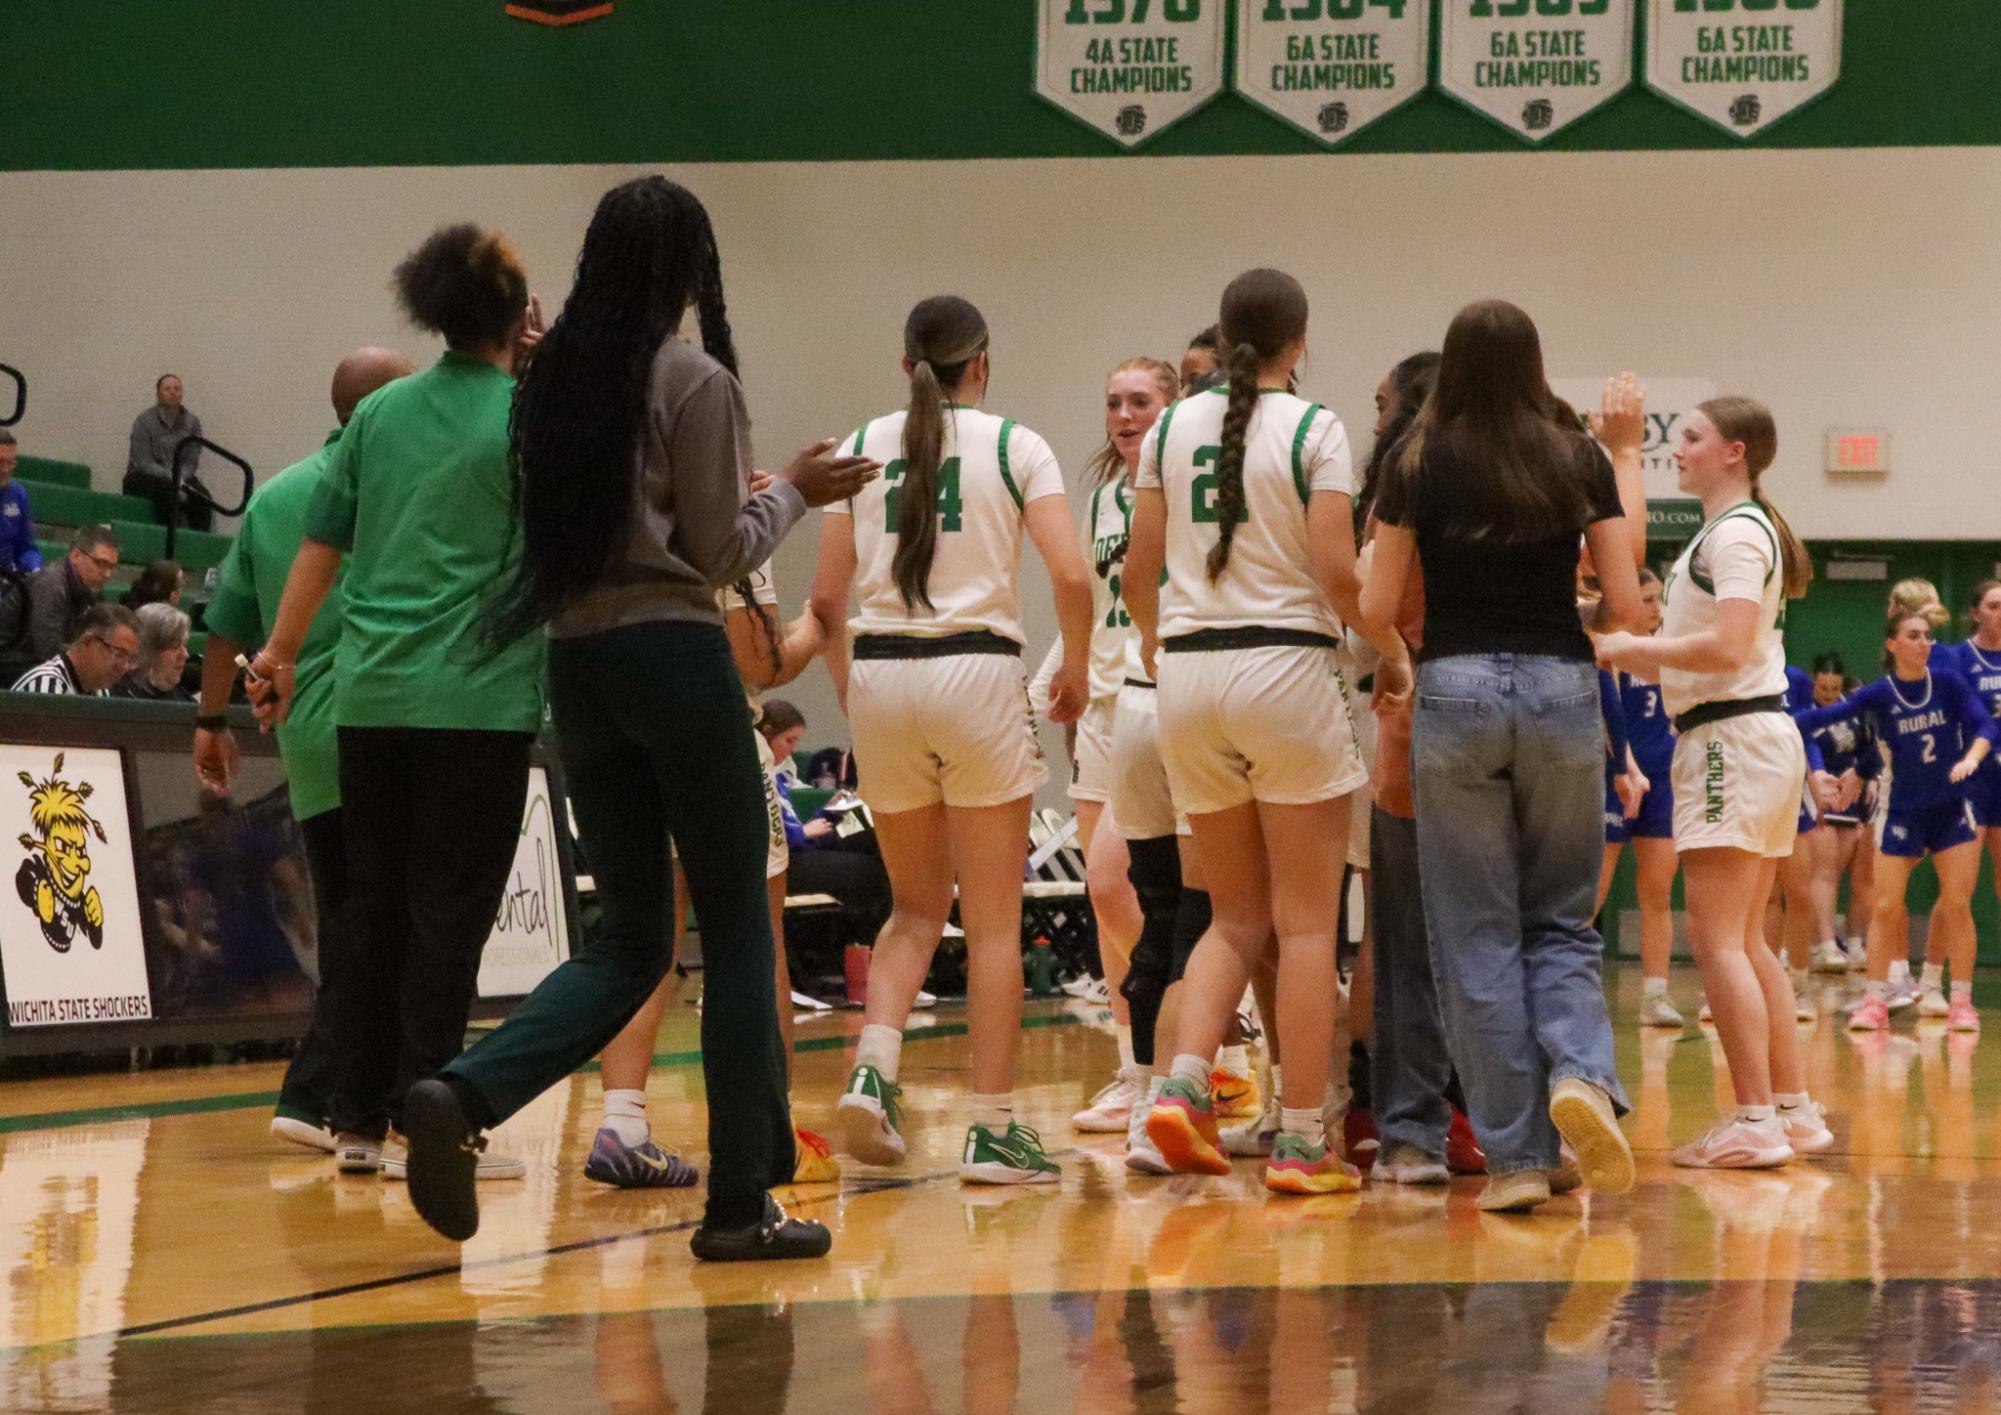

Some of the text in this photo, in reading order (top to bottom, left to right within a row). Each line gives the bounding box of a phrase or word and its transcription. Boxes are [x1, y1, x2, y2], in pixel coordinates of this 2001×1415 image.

[1086, 37, 1178, 64] 4A STATE
[1287, 33, 1380, 61] 6A STATE
[1490, 29, 1585, 57] 6A STATE
[1697, 25, 1794, 52] 6A STATE
[1071, 66, 1192, 93] CHAMPIONS
[1271, 63, 1395, 91] CHAMPIONS
[1475, 60, 1600, 87] CHAMPIONS
[1682, 54, 1809, 82] CHAMPIONS
[1644, 691, 1657, 718] 3
[1898, 709, 1946, 735] RURAL
[1921, 734, 1937, 764] 2
[1706, 741, 1724, 824] PANTHERS
[9, 995, 148, 1023] WICHITA STATE SHOCKERS
